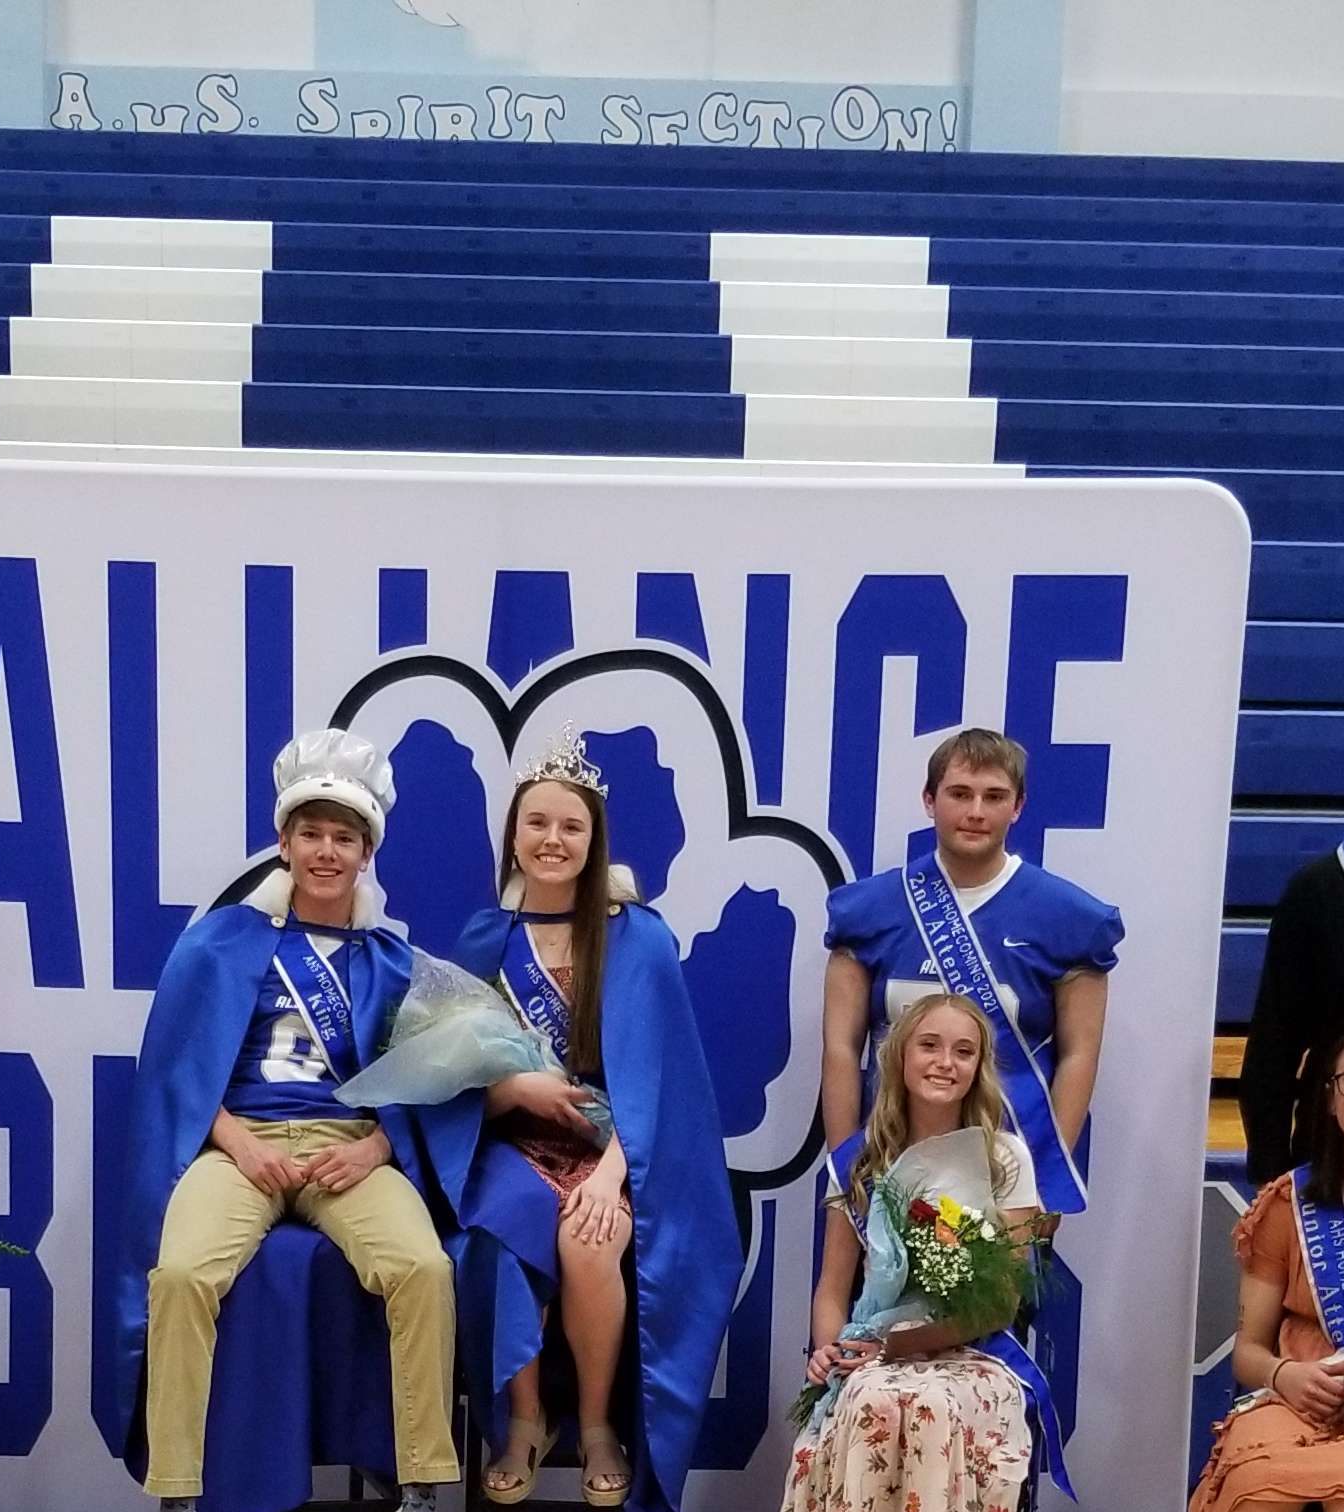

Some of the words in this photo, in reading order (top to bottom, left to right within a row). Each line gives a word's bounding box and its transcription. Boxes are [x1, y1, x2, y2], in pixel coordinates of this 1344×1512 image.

[931, 878, 952, 904] AHS
[909, 871, 939, 915] 2nd
[925, 919, 975, 996] Attend
[941, 901, 987, 984] HOMECOMING
[524, 961, 543, 985] AHS
[977, 982, 999, 1014] 2021
[307, 992, 338, 1042] King
[1301, 1195, 1328, 1274] unior
